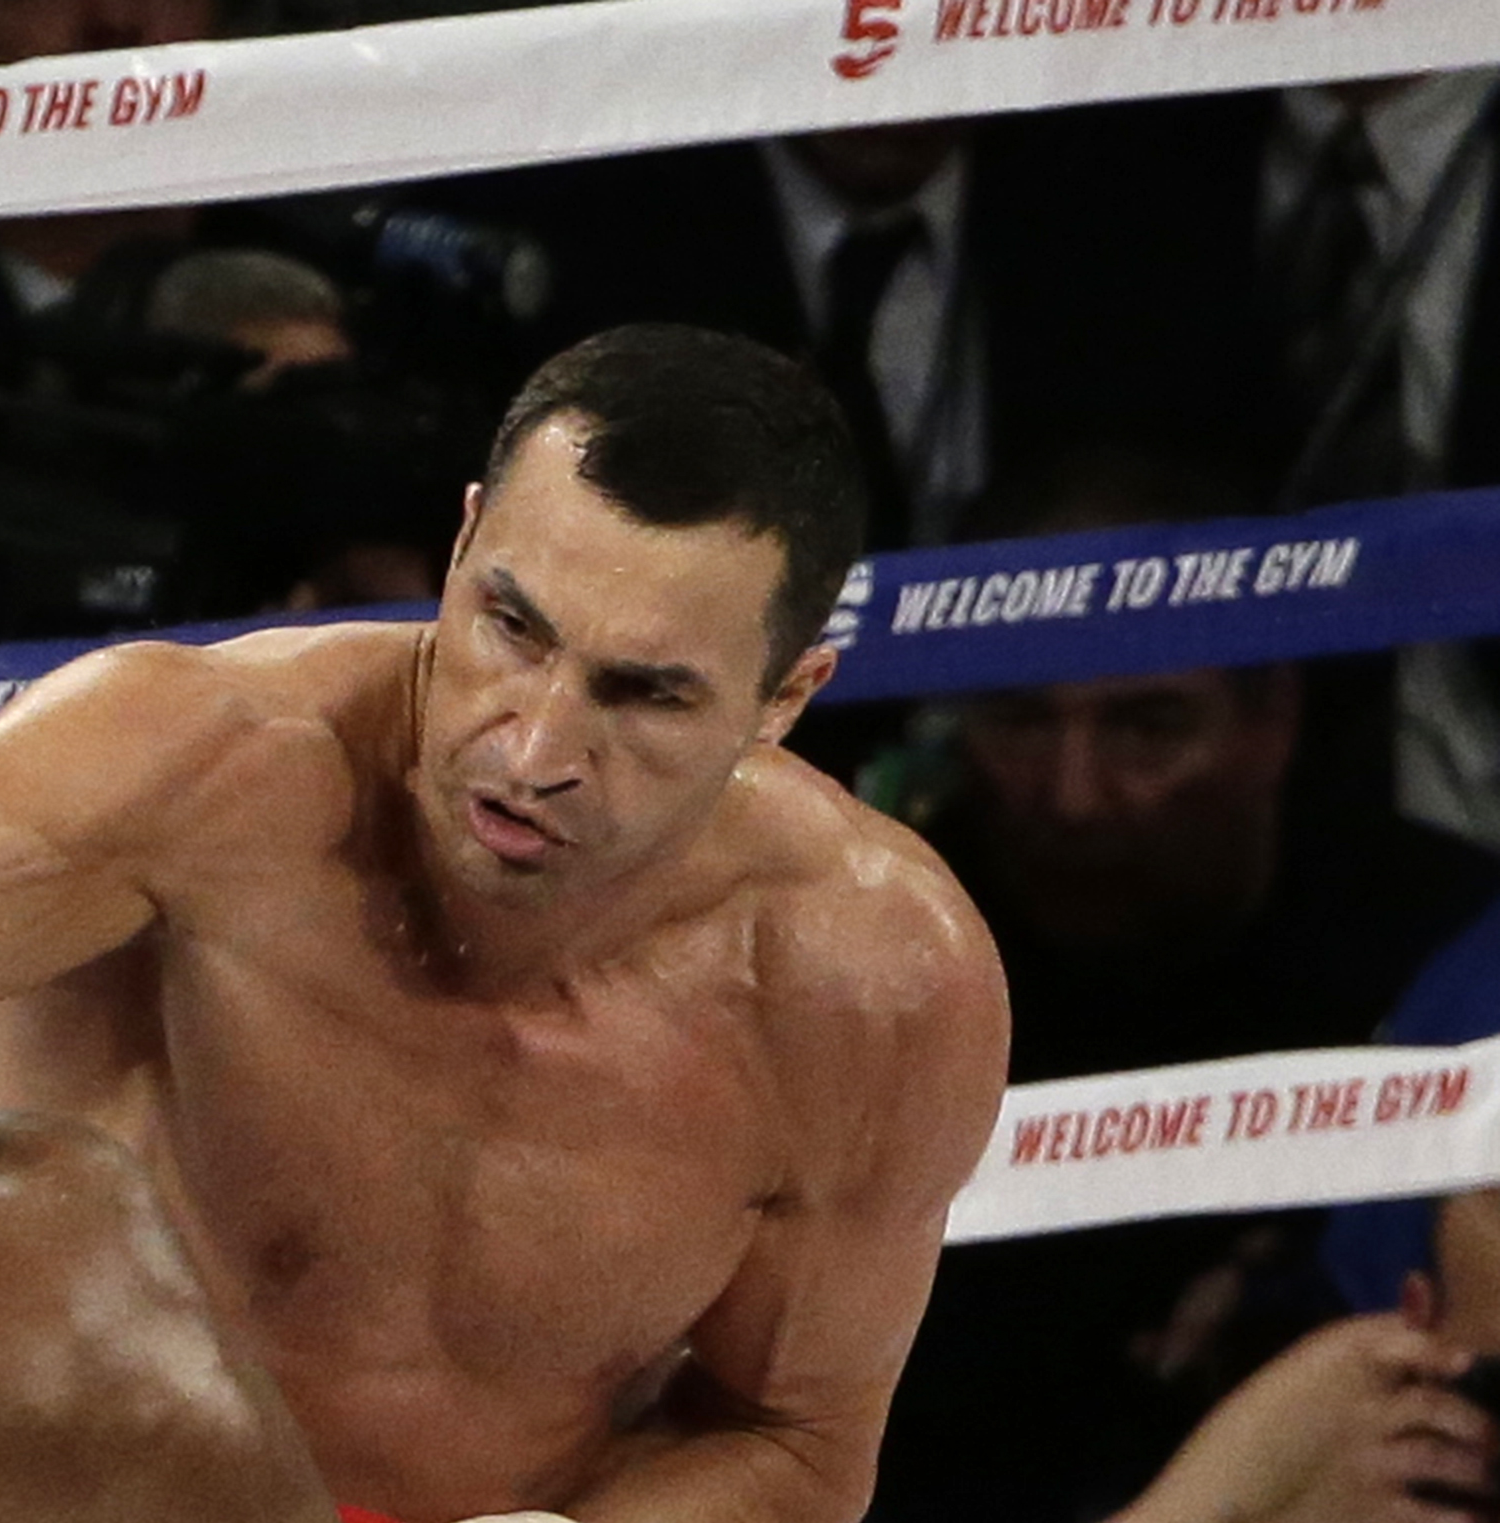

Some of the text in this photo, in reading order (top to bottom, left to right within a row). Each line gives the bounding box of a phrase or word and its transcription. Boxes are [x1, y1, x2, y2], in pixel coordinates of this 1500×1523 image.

[20, 77, 100, 133] THE
[108, 69, 208, 127] GYM
[891, 563, 1100, 634] WELCOME
[1108, 561, 1166, 609] TO
[1168, 550, 1252, 602] THE
[1254, 537, 1359, 590] GYM
[1010, 1066, 1473, 1166] WELCOME TO THE GYM
